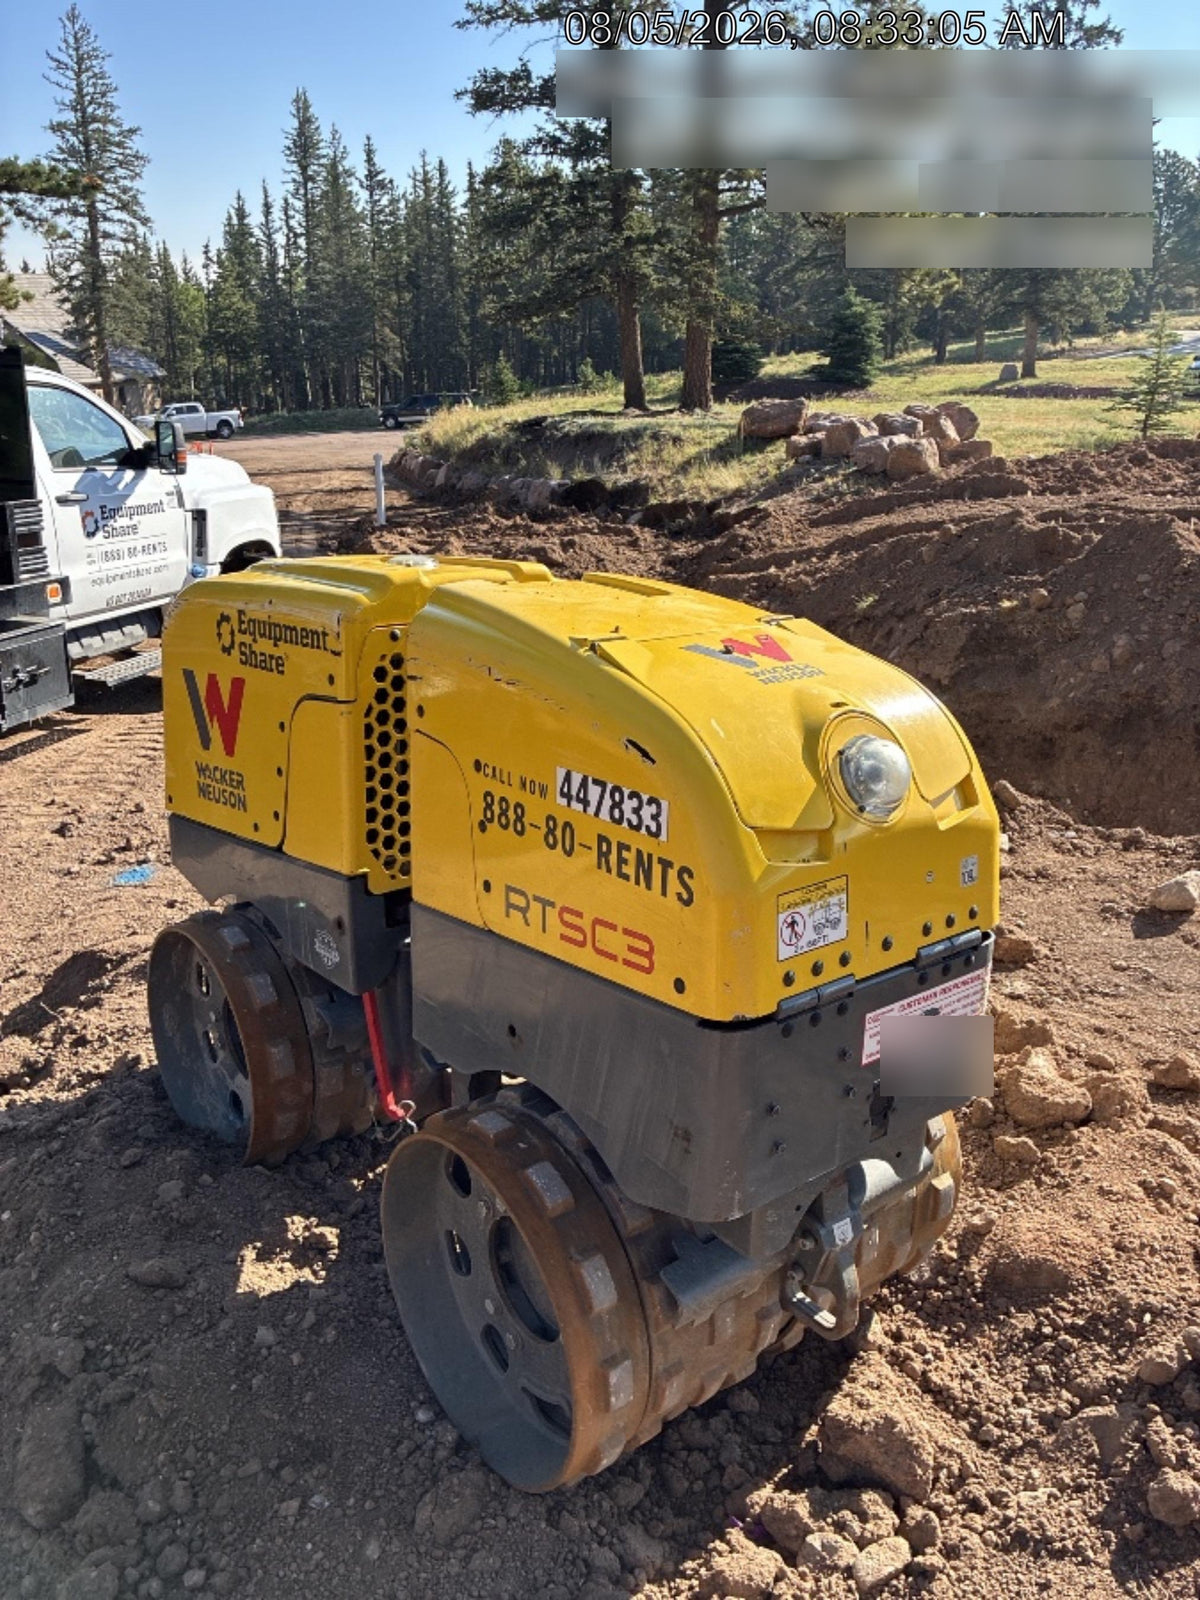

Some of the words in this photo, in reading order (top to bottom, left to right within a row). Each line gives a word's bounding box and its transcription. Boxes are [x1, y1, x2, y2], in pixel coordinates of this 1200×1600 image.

[99, 499, 166, 523] Equipment
[102, 524, 139, 539] Share
[237, 609, 329, 652] Equipment
[239, 641, 285, 675] Share
[195, 760, 245, 791] WACKER
[483, 762, 513, 787] CALL
[520, 776, 549, 800] NOW
[197, 779, 247, 813] NEUSON
[559, 769, 663, 839] 447833
[482, 790, 695, 907] 888-80-RENTS
